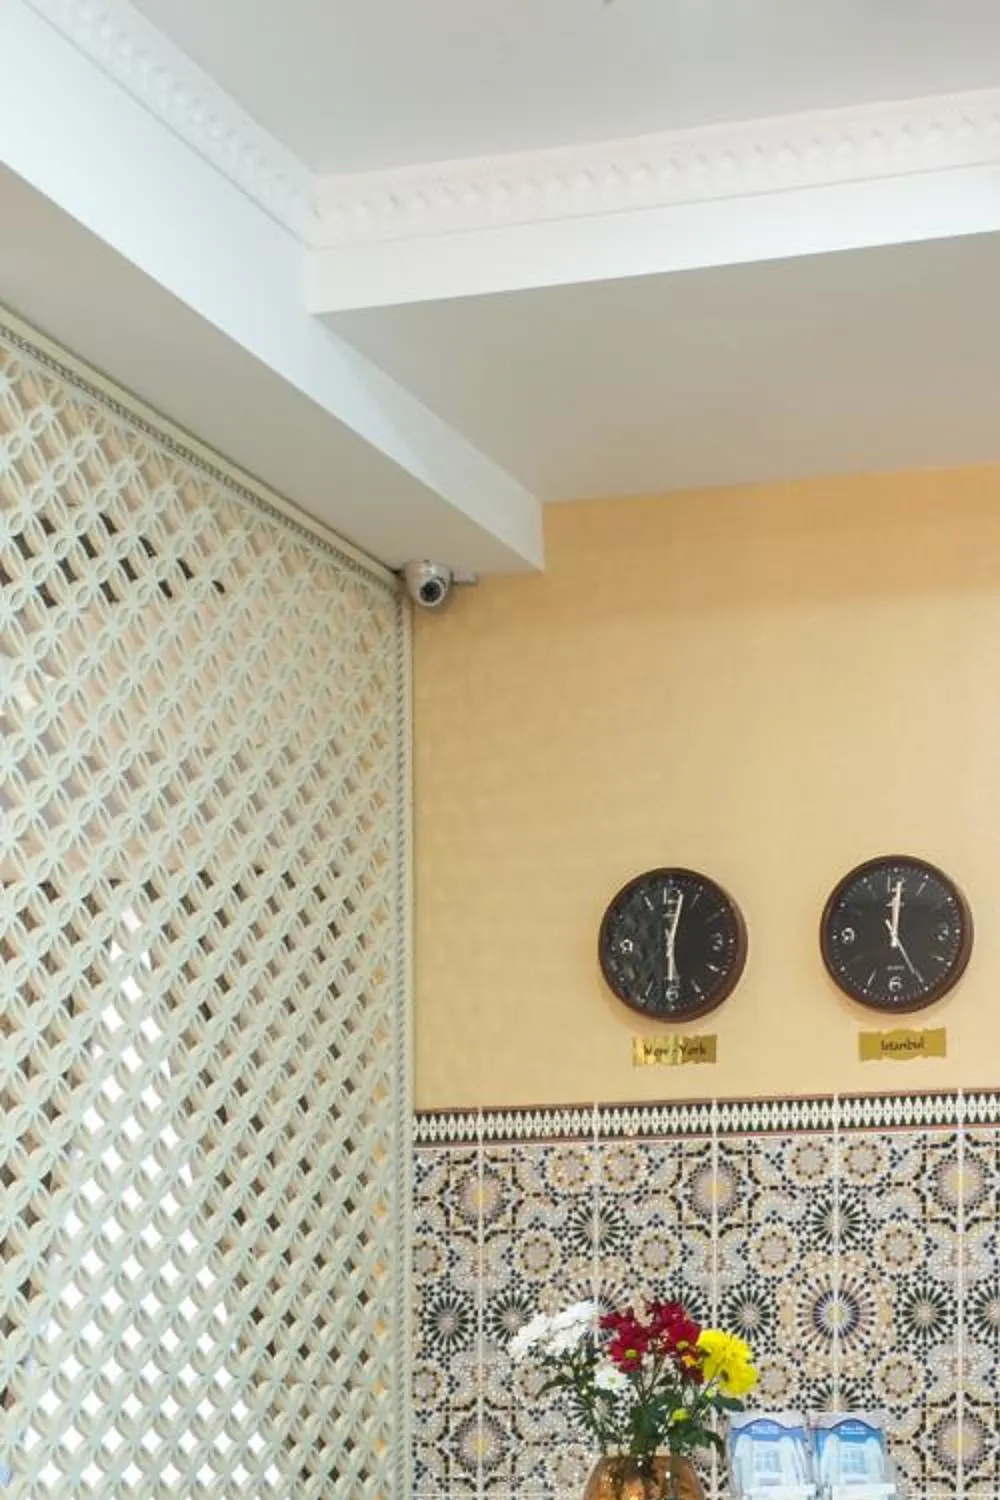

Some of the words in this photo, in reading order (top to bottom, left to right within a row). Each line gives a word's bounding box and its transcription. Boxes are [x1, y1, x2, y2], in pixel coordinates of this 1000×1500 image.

[841, 927, 855, 944] 9
[937, 923, 949, 942] 3
[620, 939, 633, 955] 9
[711, 932, 724, 951] 3
[666, 984, 680, 1001] 6
[889, 976, 902, 993] 6
[880, 1036, 925, 1051] Istanbul
